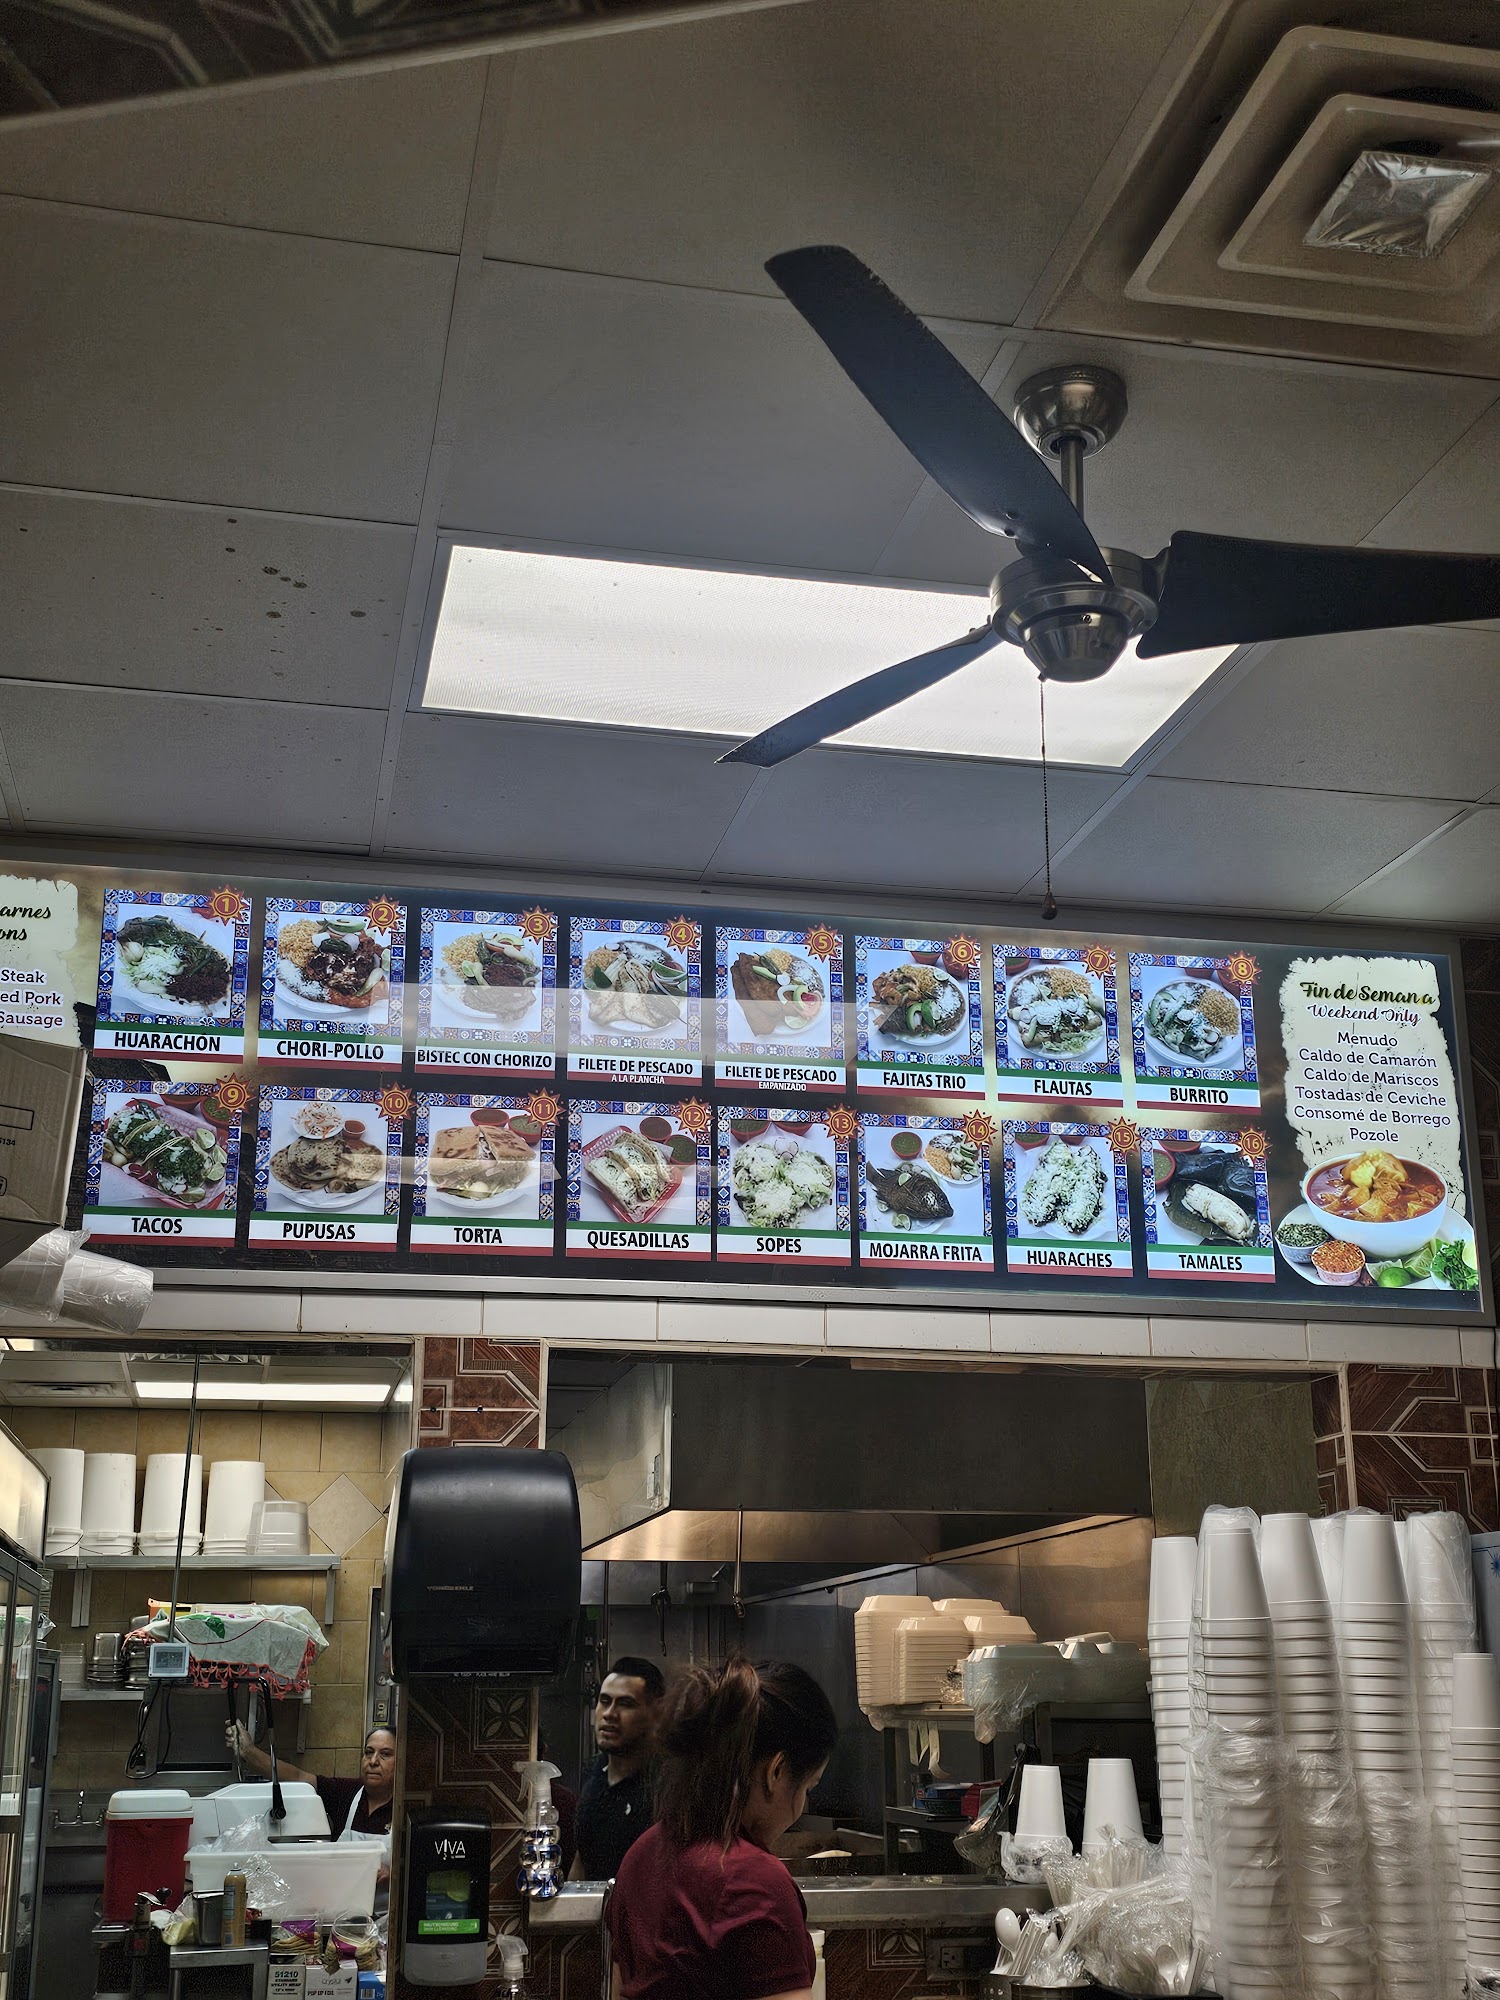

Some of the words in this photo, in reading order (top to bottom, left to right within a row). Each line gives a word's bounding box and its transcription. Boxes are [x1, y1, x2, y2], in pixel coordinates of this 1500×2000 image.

[221, 897, 230, 913] 1
[378, 908, 389, 922] 2
[532, 919, 543, 932] 3
[675, 928, 687, 940] 4
[817, 937, 828, 949] 5
[958, 945, 968, 957] 6
[1094, 955, 1103, 967] 7
[0, 969, 45, 984] Steak
[1237, 963, 1247, 976] 8
[25, 991, 61, 1005] Pork
[1299, 982, 1332, 999] Fin
[1333, 983, 1357, 1000] de
[1358, 985, 1436, 1005] Semana
[0, 1011, 63, 1029] Sausage
[1307, 1004, 1379, 1021] Weekend
[1381, 1009, 1421, 1027] Only
[114, 1031, 221, 1052] HUARACHÓN
[1337, 1031, 1398, 1047] Menudo
[276, 1040, 384, 1060] CHORI-POLLO
[1299, 1048, 1342, 1063] Caldo
[1346, 1051, 1365, 1064] de
[1368, 1052, 1437, 1068] Camarón
[417, 1049, 461, 1064] BISTEC
[463, 1052, 491, 1066] CON
[494, 1053, 552, 1068] CHORIZO
[578, 1057, 617, 1071] FILETE
[619, 1059, 635, 1072] DE
[638, 1061, 693, 1075] PESCADO
[611, 1074, 618, 1083] A
[618, 1074, 629, 1083] LA
[629, 1075, 665, 1085] PLANCHA
[725, 1065, 762, 1079] FILETE
[765, 1067, 780, 1080] DE
[783, 1068, 837, 1083] PESCADO
[883, 1071, 933, 1088] FAJITAS
[934, 1074, 966, 1089] TRIO
[1304, 1067, 1347, 1082] Caldo
[1351, 1070, 1370, 1083] de
[1374, 1071, 1439, 1087] Mariscos
[758, 1081, 807, 1092] EMPANIZADO
[1034, 1079, 1092, 1096] FLAUTAS
[226, 1089, 239, 1103] 9
[387, 1096, 404, 1110] 10
[1170, 1087, 1228, 1104] BURRITO
[1295, 1086, 1361, 1102] Tostadas
[1365, 1089, 1384, 1103] de
[1387, 1091, 1447, 1106] Ceviche
[536, 1103, 552, 1116] 11
[685, 1111, 702, 1123] 12
[1294, 1105, 1365, 1121] Consomé
[1369, 1109, 1388, 1122] de
[1392, 1110, 1451, 1128] Borrego
[834, 1117, 850, 1130] 13
[969, 1124, 986, 1136] 14
[1115, 1131, 1130, 1143] 15
[1350, 1128, 1399, 1142] Pozole
[1246, 1138, 1259, 1150] 16
[131, 1217, 183, 1234] TACOS
[283, 1222, 356, 1240] PUPUSAS
[453, 1227, 503, 1244] TORTA
[587, 1230, 690, 1249] QUESADILLAS
[756, 1237, 802, 1253] SOPES
[869, 1242, 940, 1260] MOJARRA
[942, 1245, 983, 1262] FRITA
[1027, 1250, 1113, 1268] HUARACHES
[1178, 1254, 1243, 1271] TAMALES
[275, 1970, 299, 1978] 51210
